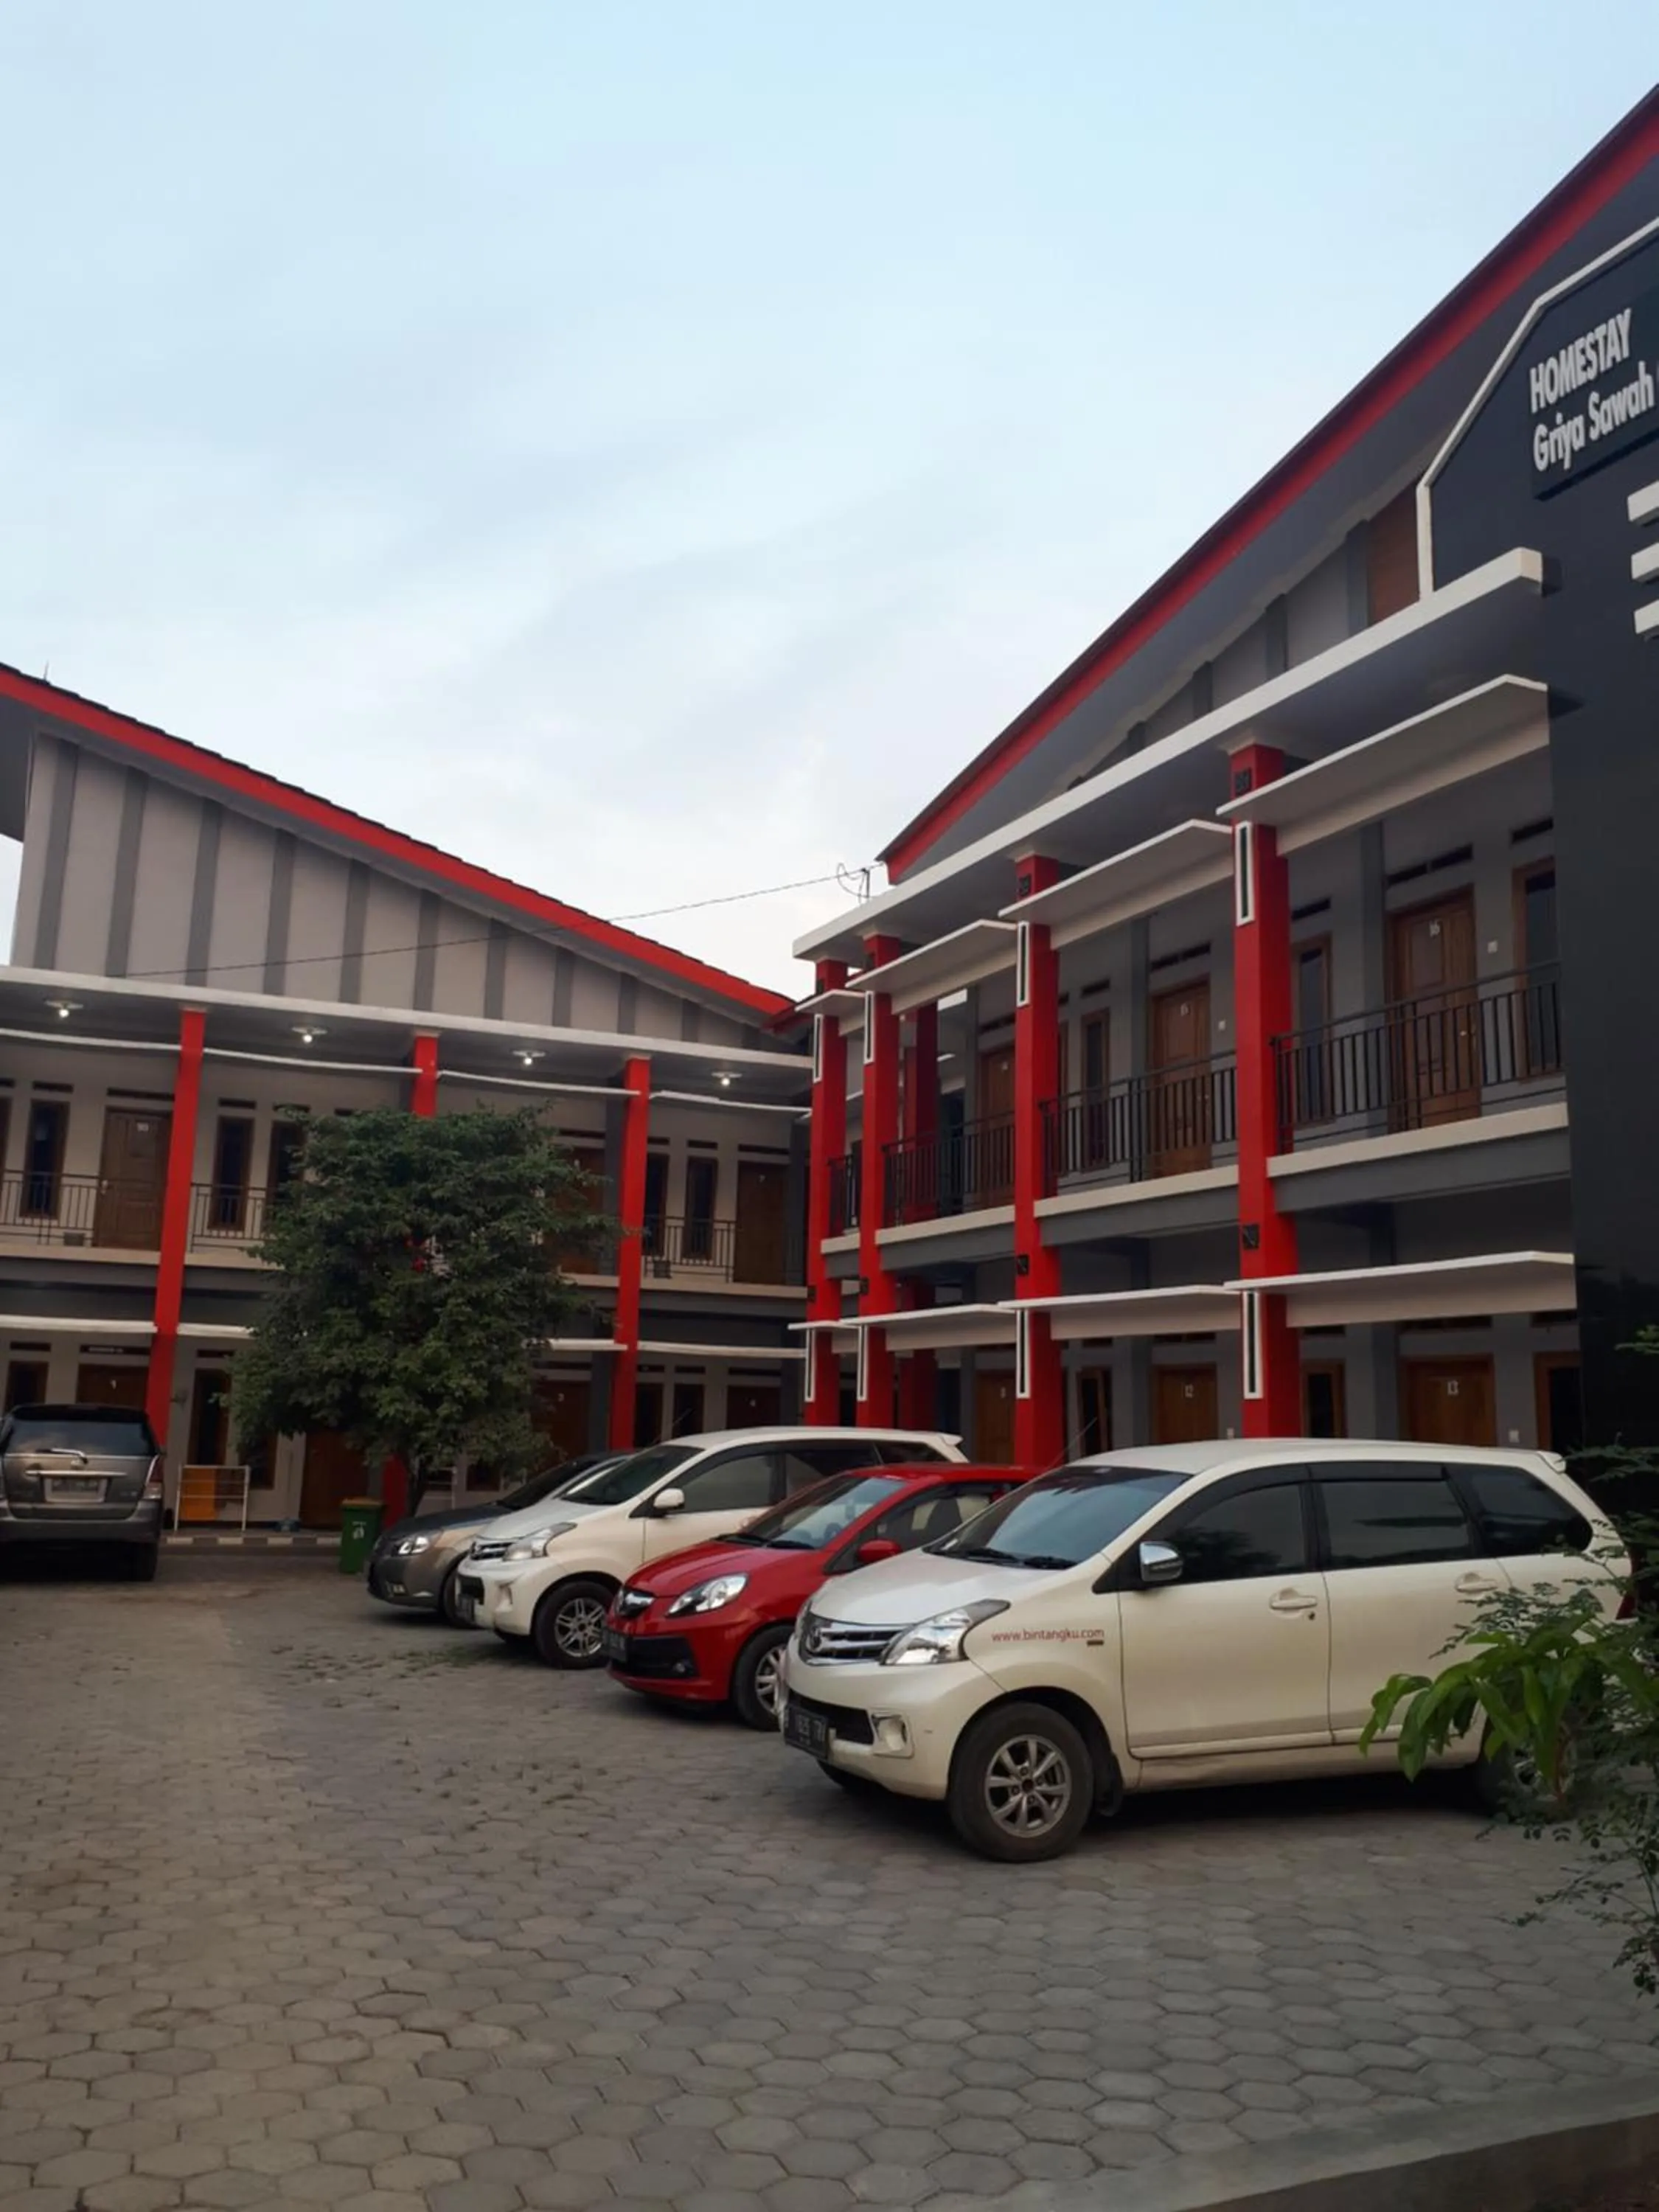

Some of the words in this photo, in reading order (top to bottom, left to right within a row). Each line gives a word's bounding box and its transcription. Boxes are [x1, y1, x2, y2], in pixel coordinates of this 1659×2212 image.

[1530, 307, 1631, 414] HOMESTAY
[1534, 411, 1585, 471] Griya
[1588, 360, 1655, 441] Sawah
[991, 1628, 1105, 1643] www.bintangku.com
